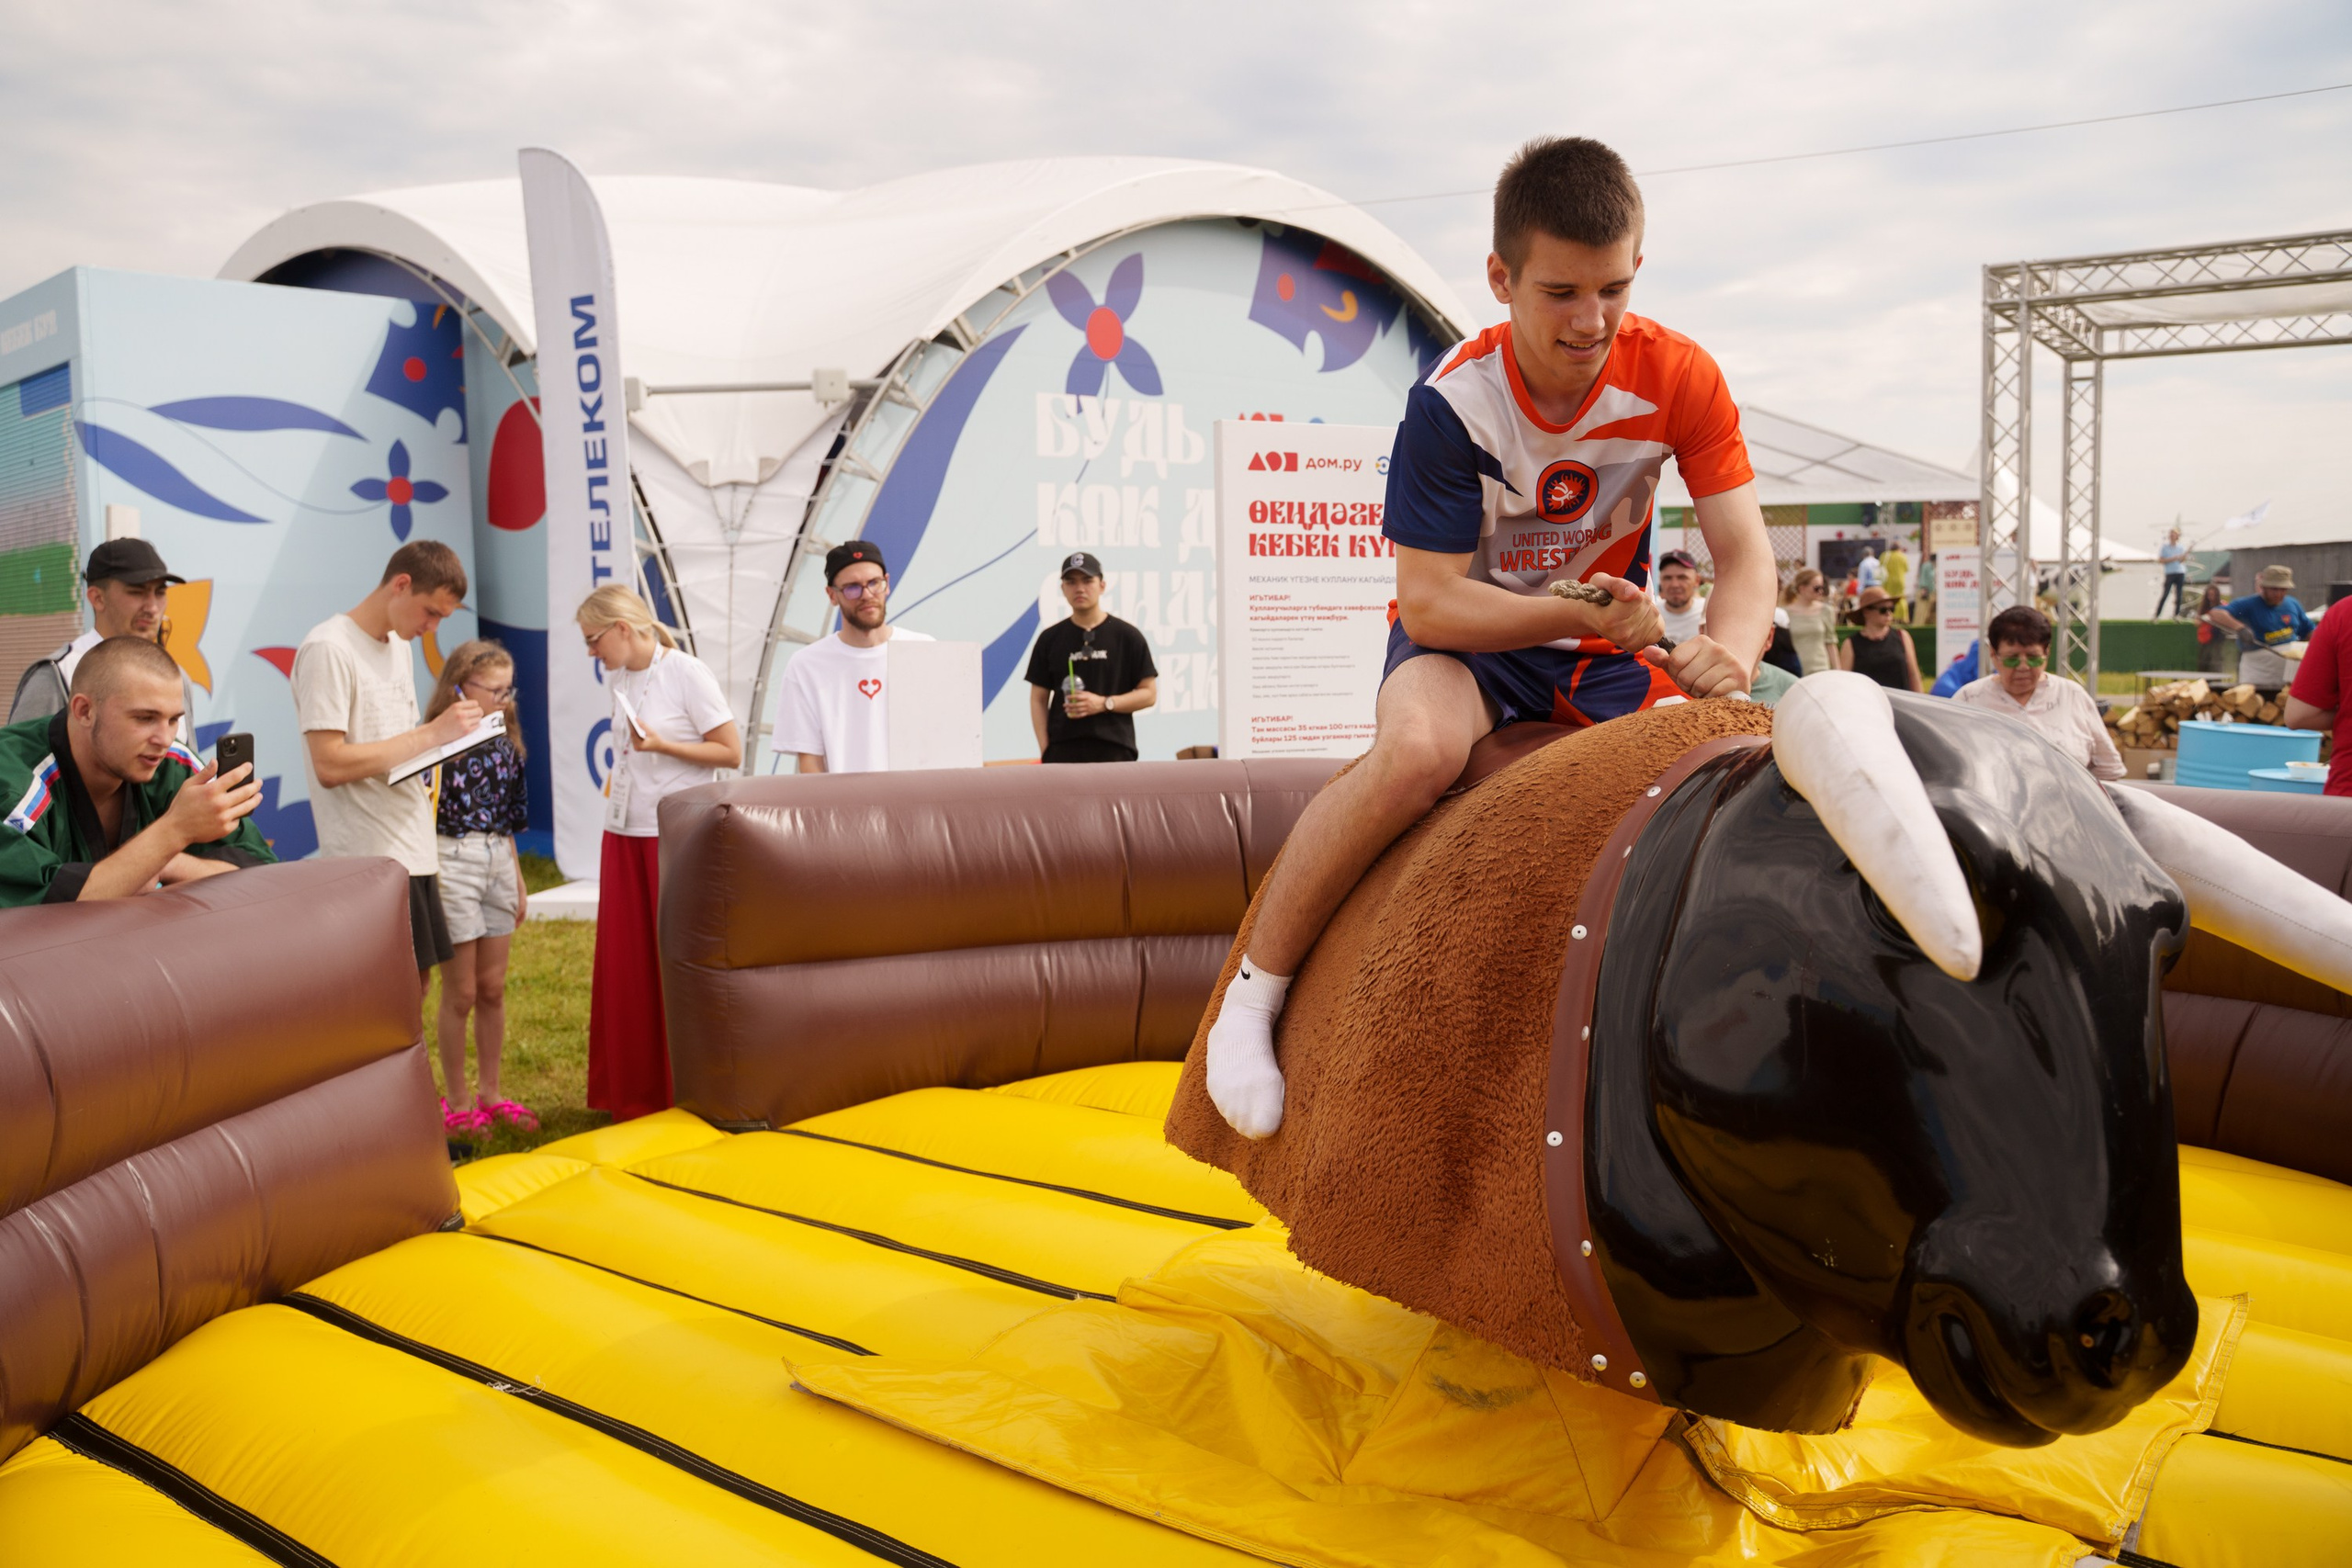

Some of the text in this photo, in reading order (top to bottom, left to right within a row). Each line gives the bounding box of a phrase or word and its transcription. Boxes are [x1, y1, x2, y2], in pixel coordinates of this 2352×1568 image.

[570, 293, 613, 589] ТЕЛЕКОМ
[1035, 391, 1205, 479] БУДЬ
[1306, 457, 1363, 472] дом.ру
[1037, 482, 1216, 564] КАК Д
[1249, 533, 1340, 558] КЕБЕК
[1512, 528, 1597, 548] UNITED WOR
[1250, 575, 1288, 583] МЕХАНИК
[1358, 574, 1396, 584] КАГЫЙДӘ
